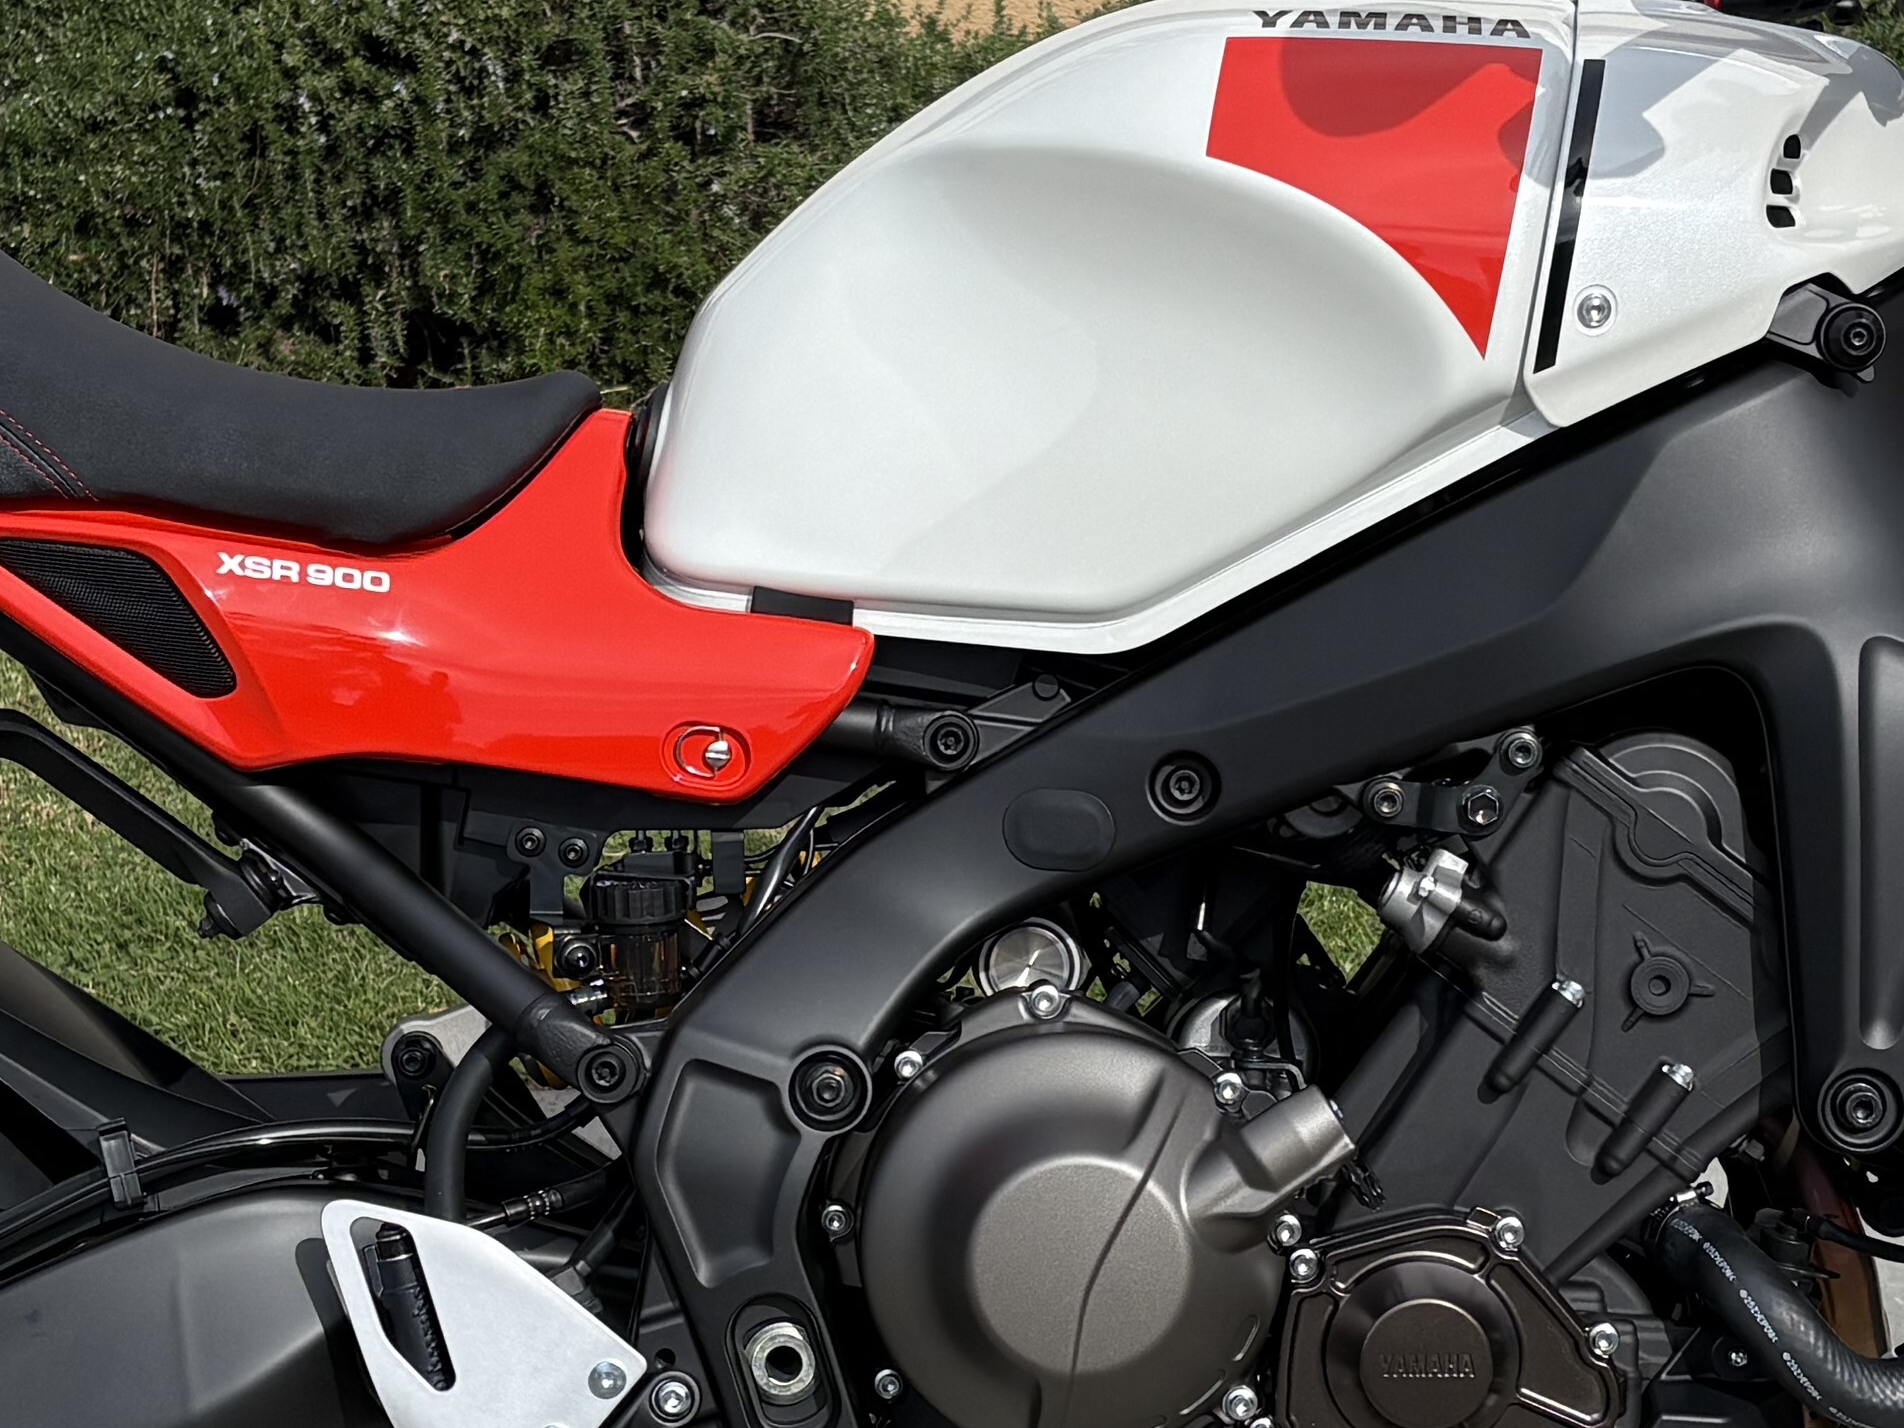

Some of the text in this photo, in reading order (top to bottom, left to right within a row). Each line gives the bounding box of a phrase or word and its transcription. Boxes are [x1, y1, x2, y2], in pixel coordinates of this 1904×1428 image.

[1253, 10, 1531, 40] YAMAHA
[217, 551, 391, 594] XSR 900
[1379, 1352, 1475, 1378] YAMAHA
